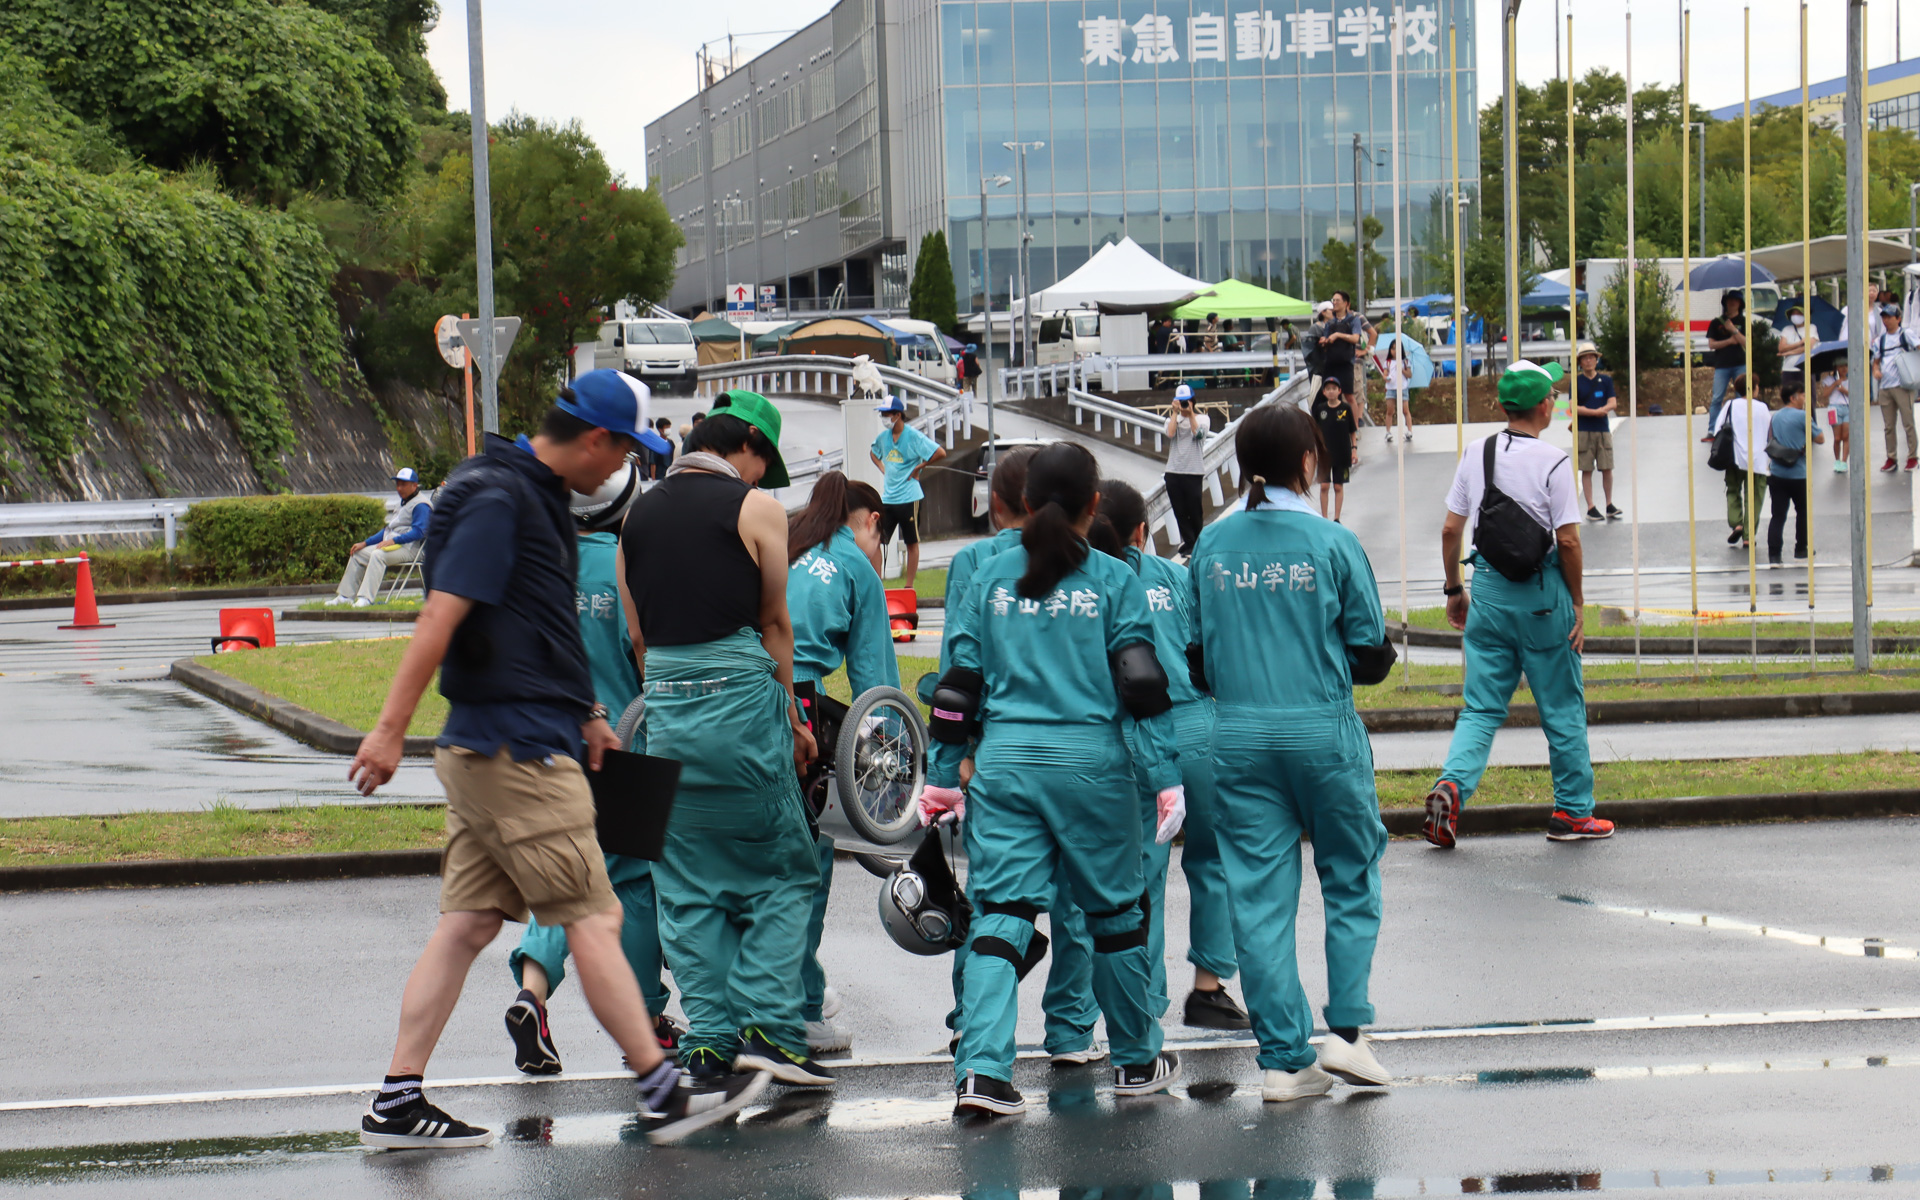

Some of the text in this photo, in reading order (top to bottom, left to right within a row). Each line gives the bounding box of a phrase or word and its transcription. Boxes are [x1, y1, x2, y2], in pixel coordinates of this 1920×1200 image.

[1078, 5, 1438, 66] 東急自動車学校
[737, 302, 745, 311] P
[764, 295, 772, 303] P
[1207, 562, 1317, 593] 青山学院
[988, 587, 1100, 618] 青山学院
